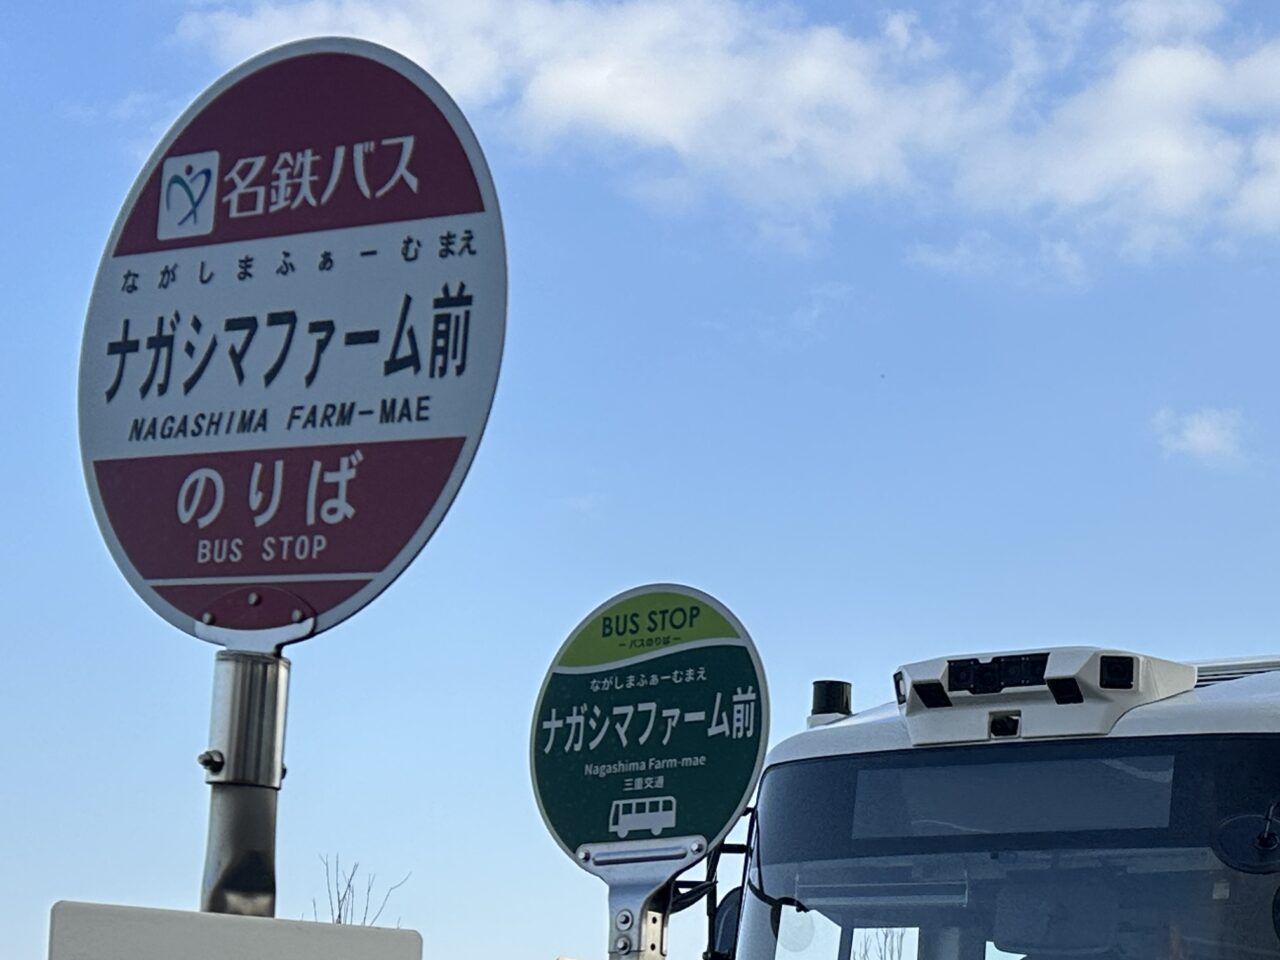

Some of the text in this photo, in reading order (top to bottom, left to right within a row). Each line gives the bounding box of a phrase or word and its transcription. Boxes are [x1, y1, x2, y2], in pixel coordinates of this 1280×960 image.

[222, 135, 419, 219] 名鉄バス
[121, 230, 478, 293] ながしまふぁーむまえ
[104, 281, 474, 402] ナガシマファーム前
[128, 396, 431, 442] NAGASHIMA FARM-MAE
[177, 449, 363, 528] のりば
[197, 535, 327, 563] BUS STOP
[602, 606, 700, 637] BUS STOP
[629, 635, 671, 649] バスのりば
[589, 666, 707, 692] ながしまふぁーむまえ
[542, 685, 757, 754] ナガシマファーム前
[584, 754, 706, 778] Nagashima Farm-mae
[623, 775, 665, 791] 三重交通
